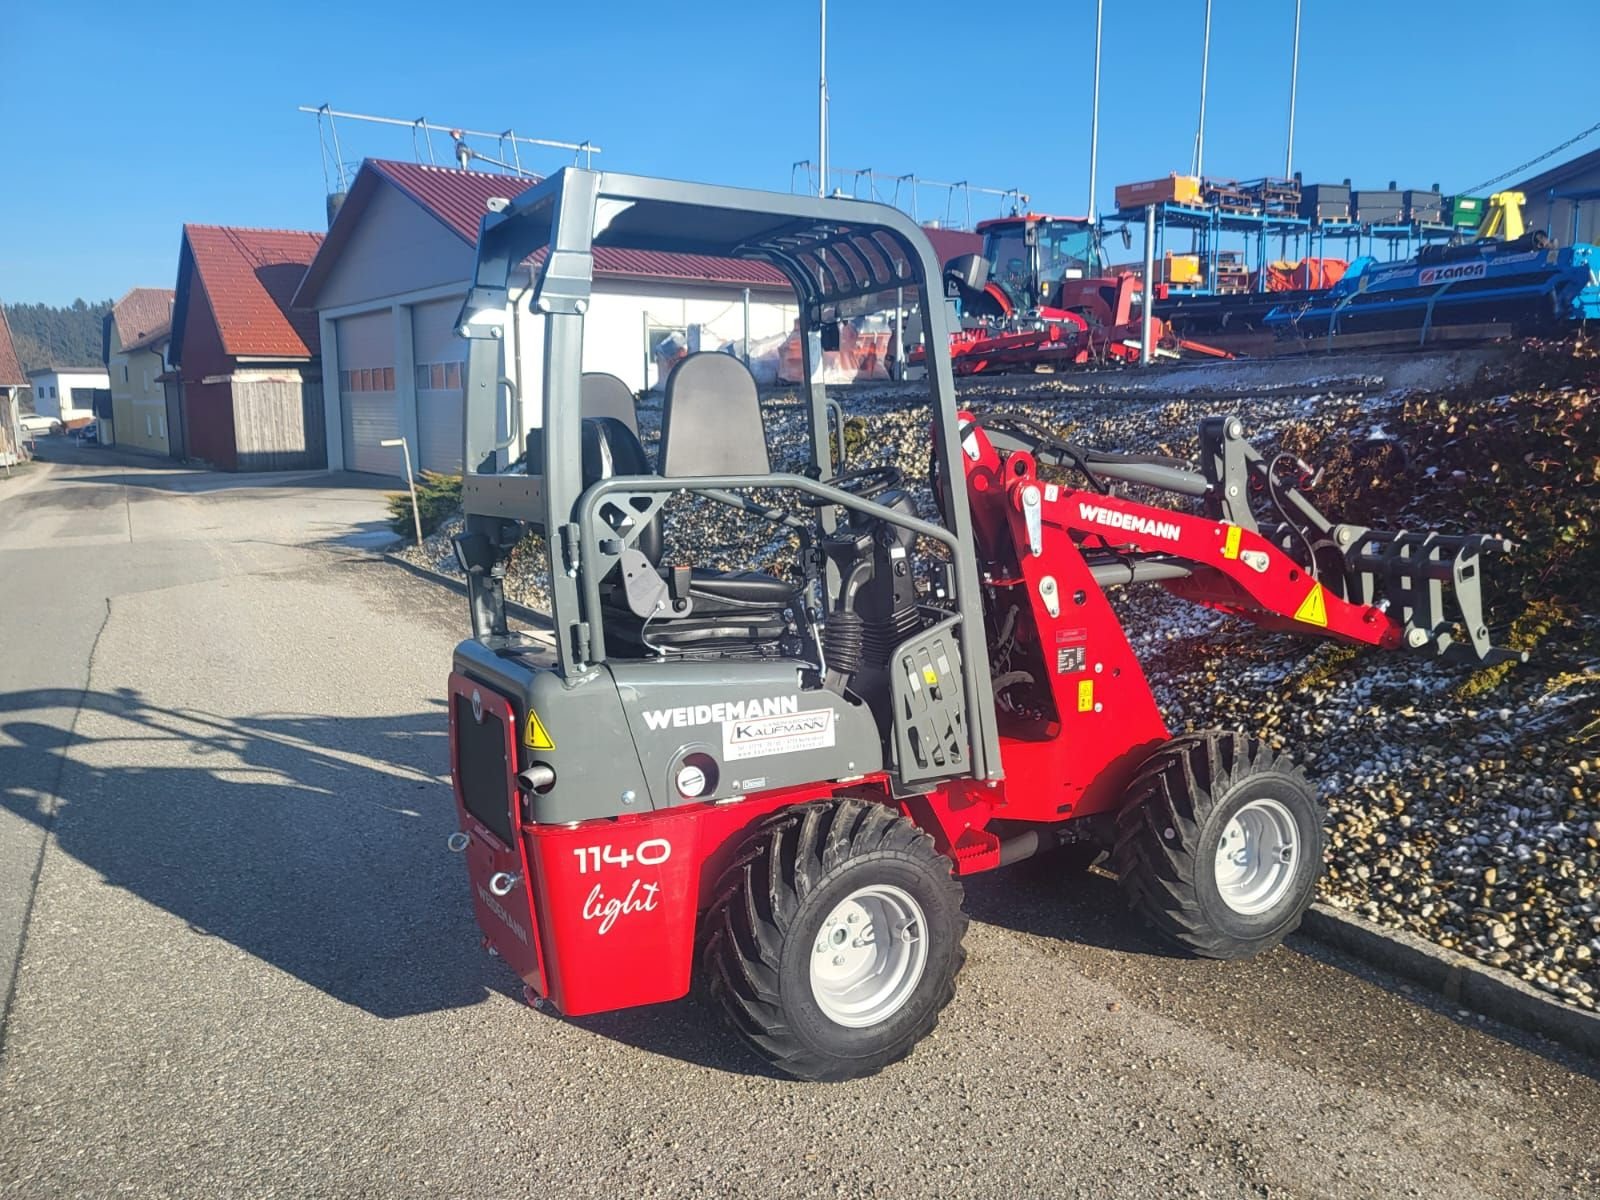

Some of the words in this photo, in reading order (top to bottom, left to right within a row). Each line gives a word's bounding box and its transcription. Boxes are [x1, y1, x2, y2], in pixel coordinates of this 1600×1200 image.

[1079, 503, 1181, 541] WEIDEMANN
[642, 695, 798, 730] WEIDEMANN
[573, 838, 672, 874] 1140
[582, 879, 660, 935] light
